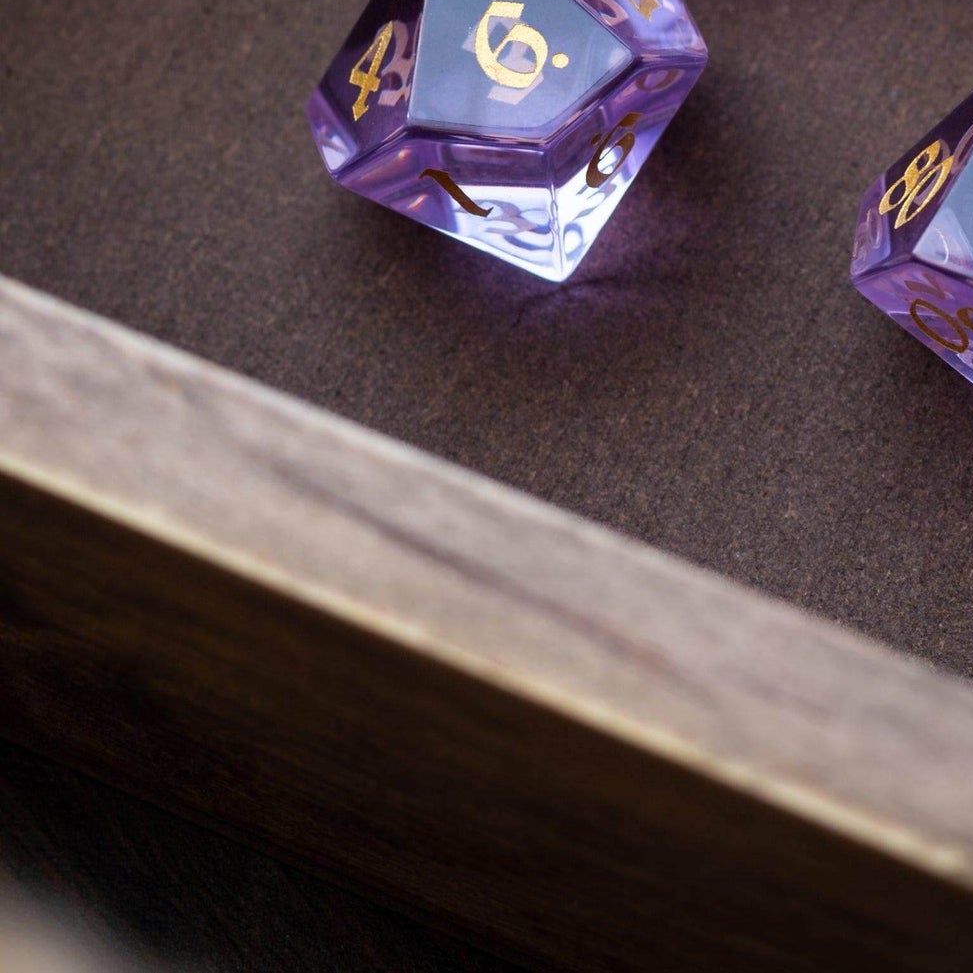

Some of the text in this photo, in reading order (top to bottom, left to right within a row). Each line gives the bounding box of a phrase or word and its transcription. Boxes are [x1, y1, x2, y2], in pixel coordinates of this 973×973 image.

[348, 20, 394, 123] 4
[418, 168, 494, 218] 1
[878, 138, 954, 229] 80
